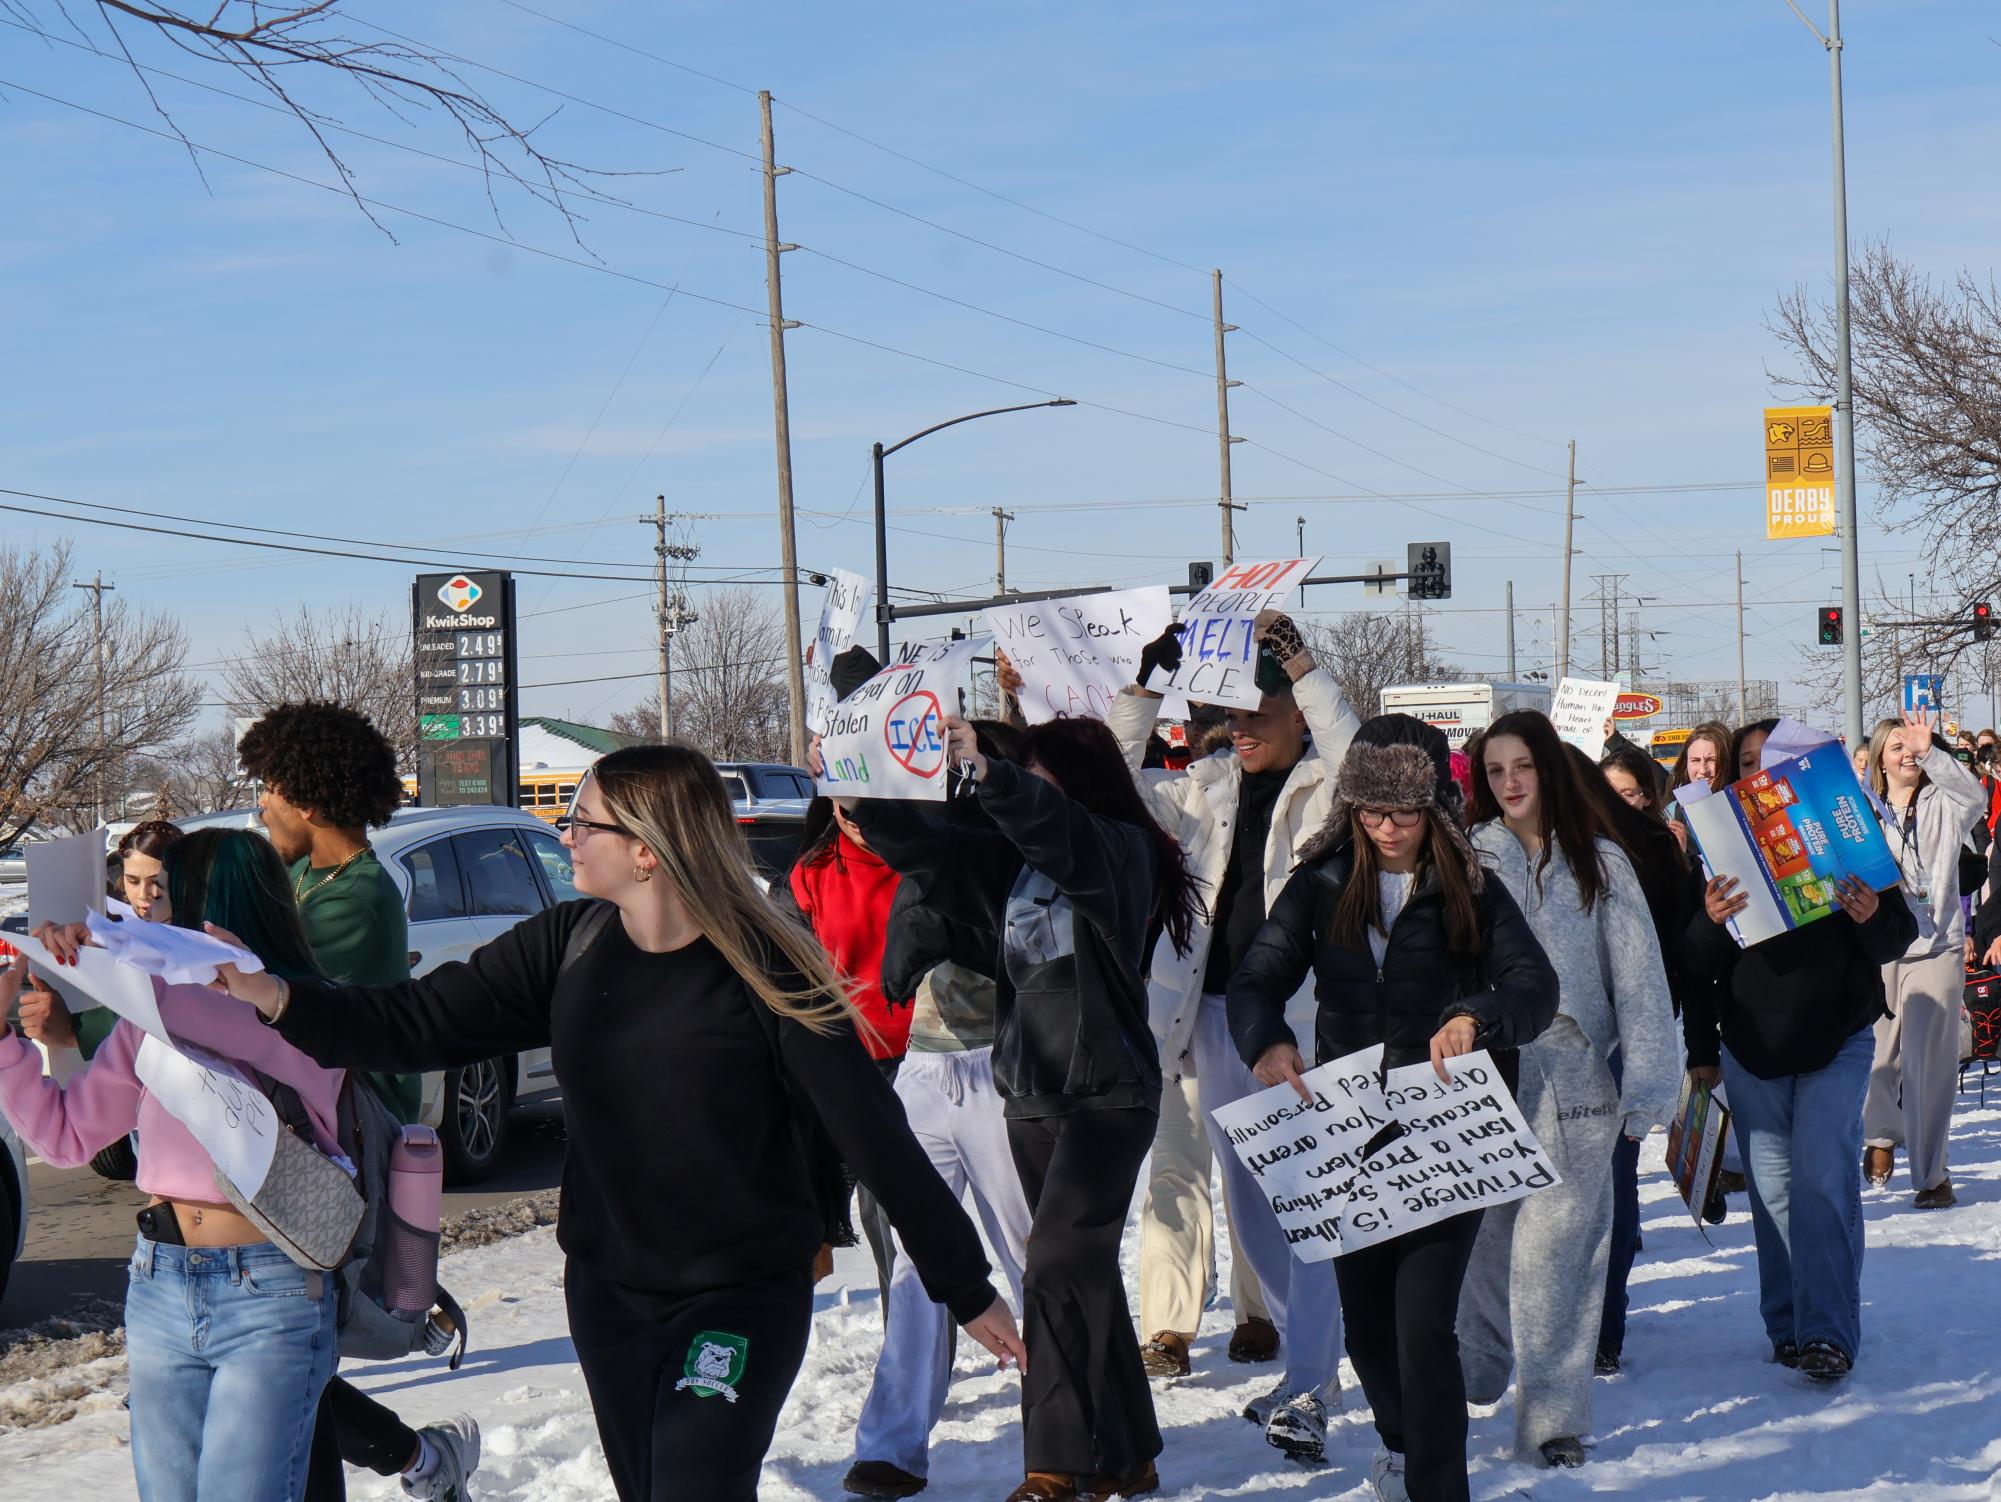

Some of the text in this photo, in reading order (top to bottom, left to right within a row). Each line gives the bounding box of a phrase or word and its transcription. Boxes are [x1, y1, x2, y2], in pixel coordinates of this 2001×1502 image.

[1771, 487, 1830, 513] DERBY
[1772, 513, 1831, 525] PROUD
[1211, 559, 1311, 590] HOT
[1188, 591, 1285, 614] PEOPLE
[426, 613, 496, 629] KwikShop
[993, 613, 1045, 639] We
[1175, 617, 1254, 664] MELT
[1011, 647, 1037, 670] for
[1109, 654, 1133, 666] who
[1911, 679, 1935, 706] H
[1414, 710, 1460, 721] U-HAUL
[889, 714, 942, 753] ICE
[819, 750, 870, 783] Land
[1812, 821, 1829, 845] PURE
[1831, 808, 1853, 839] PURE
[1835, 795, 1865, 844] PROTEIN
[1801, 818, 1825, 856] PROTEIN
[1399, 1094, 1504, 1138] because
[1429, 1139, 1451, 1154] a
[1386, 1159, 1475, 1192] think
[1402, 1161, 1556, 1213] Privilege
